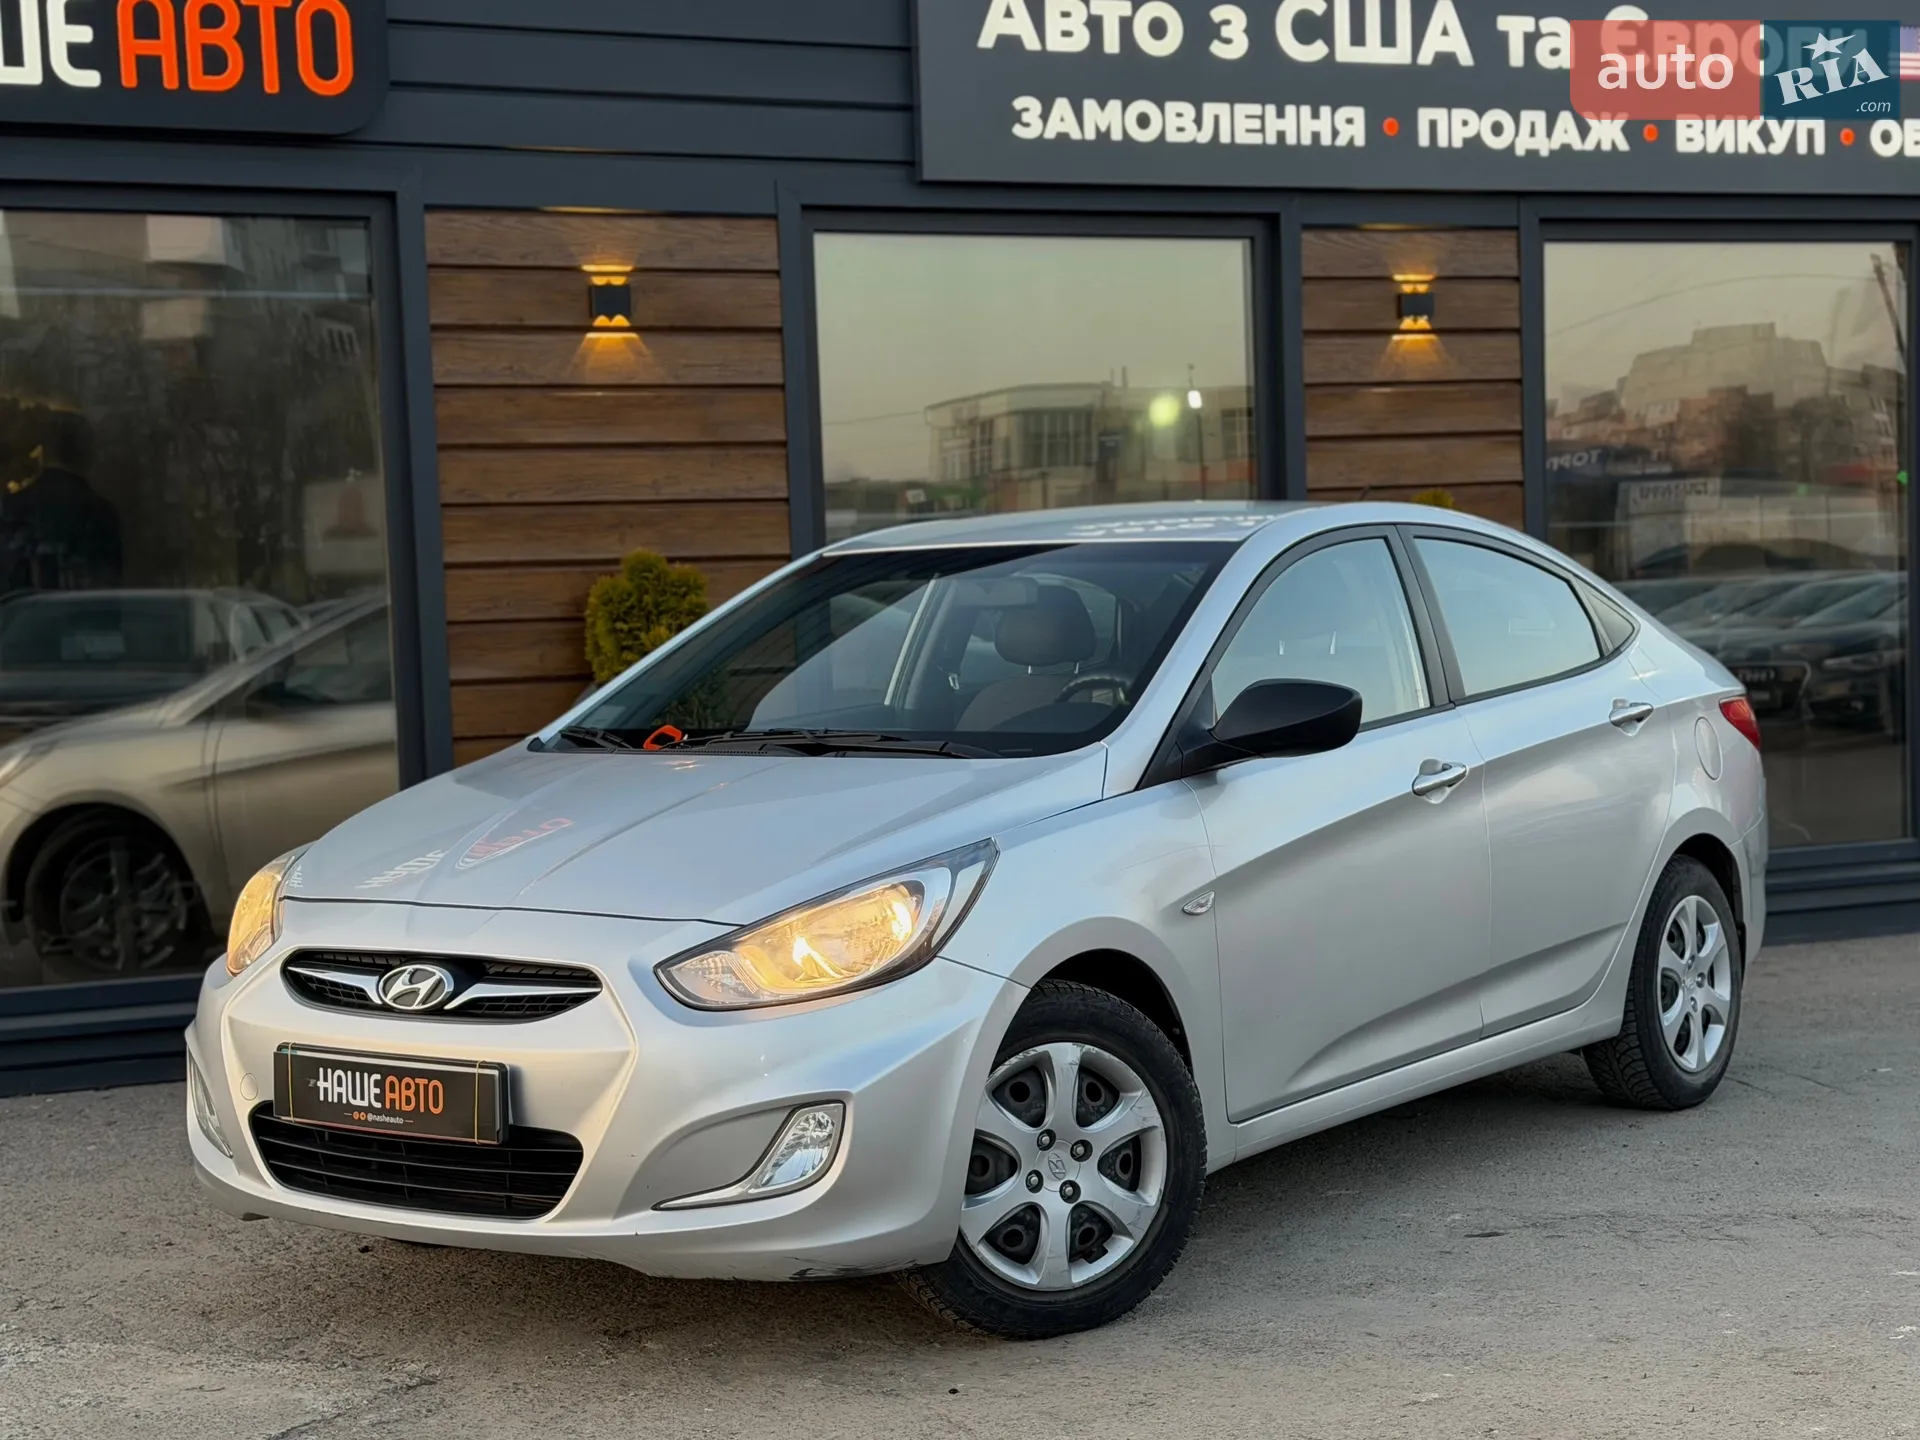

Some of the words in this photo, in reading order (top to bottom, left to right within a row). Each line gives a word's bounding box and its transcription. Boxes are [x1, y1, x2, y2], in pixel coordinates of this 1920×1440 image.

[117, 0, 354, 96] АВТО
[977, 0, 1184, 57] Авто
[1275, 0, 1475, 66] США
[1011, 95, 1366, 147] ЗАМОВЛЕННЯ
[1417, 107, 1631, 157] ПРОДАЖ
[1675, 113, 1826, 155] ВИКУП
[317, 1067, 382, 1108] НАШЕ
[385, 1076, 443, 1114] АВТО
[367, 1112, 404, 1124] @nasheauto
